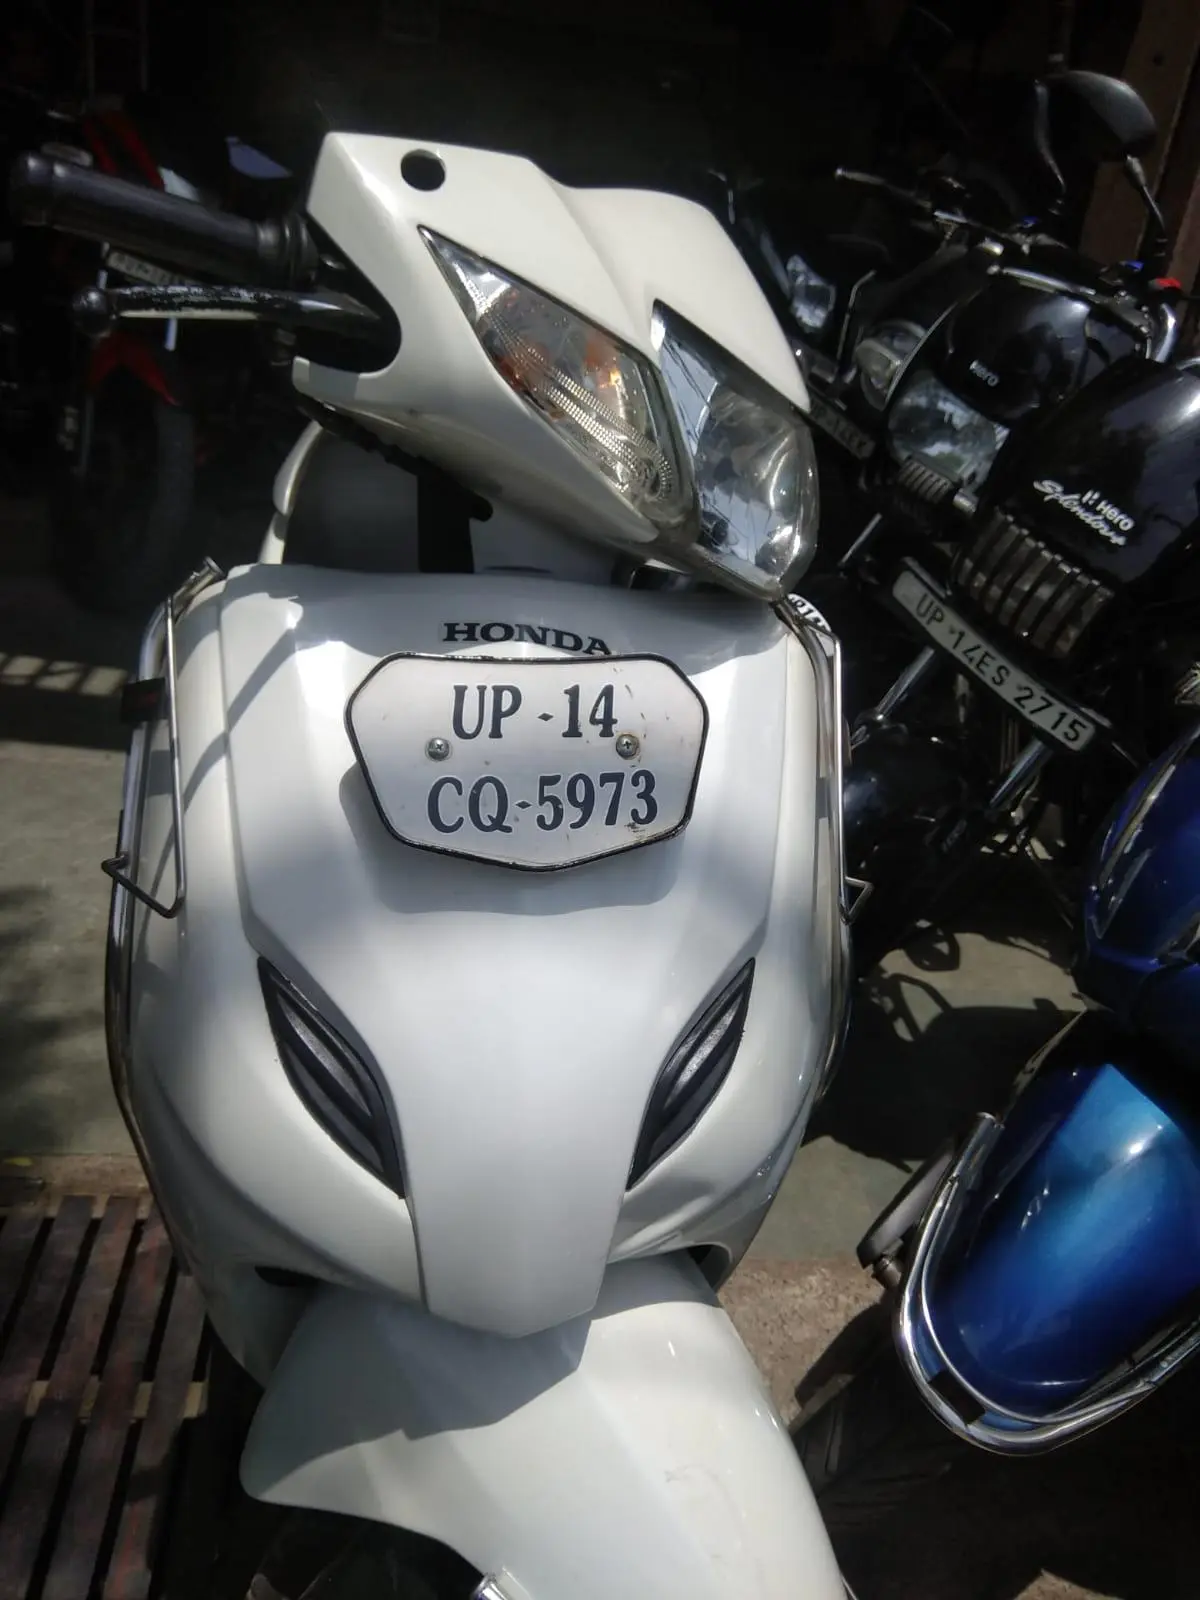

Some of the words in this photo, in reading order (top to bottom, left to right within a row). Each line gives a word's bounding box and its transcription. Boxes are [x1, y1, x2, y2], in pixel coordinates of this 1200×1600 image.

[1095, 499, 1136, 531] Hero
[915, 593, 945, 626] UP
[442, 622, 613, 655] HONDA
[427, 769, 659, 834] CQ-5973
